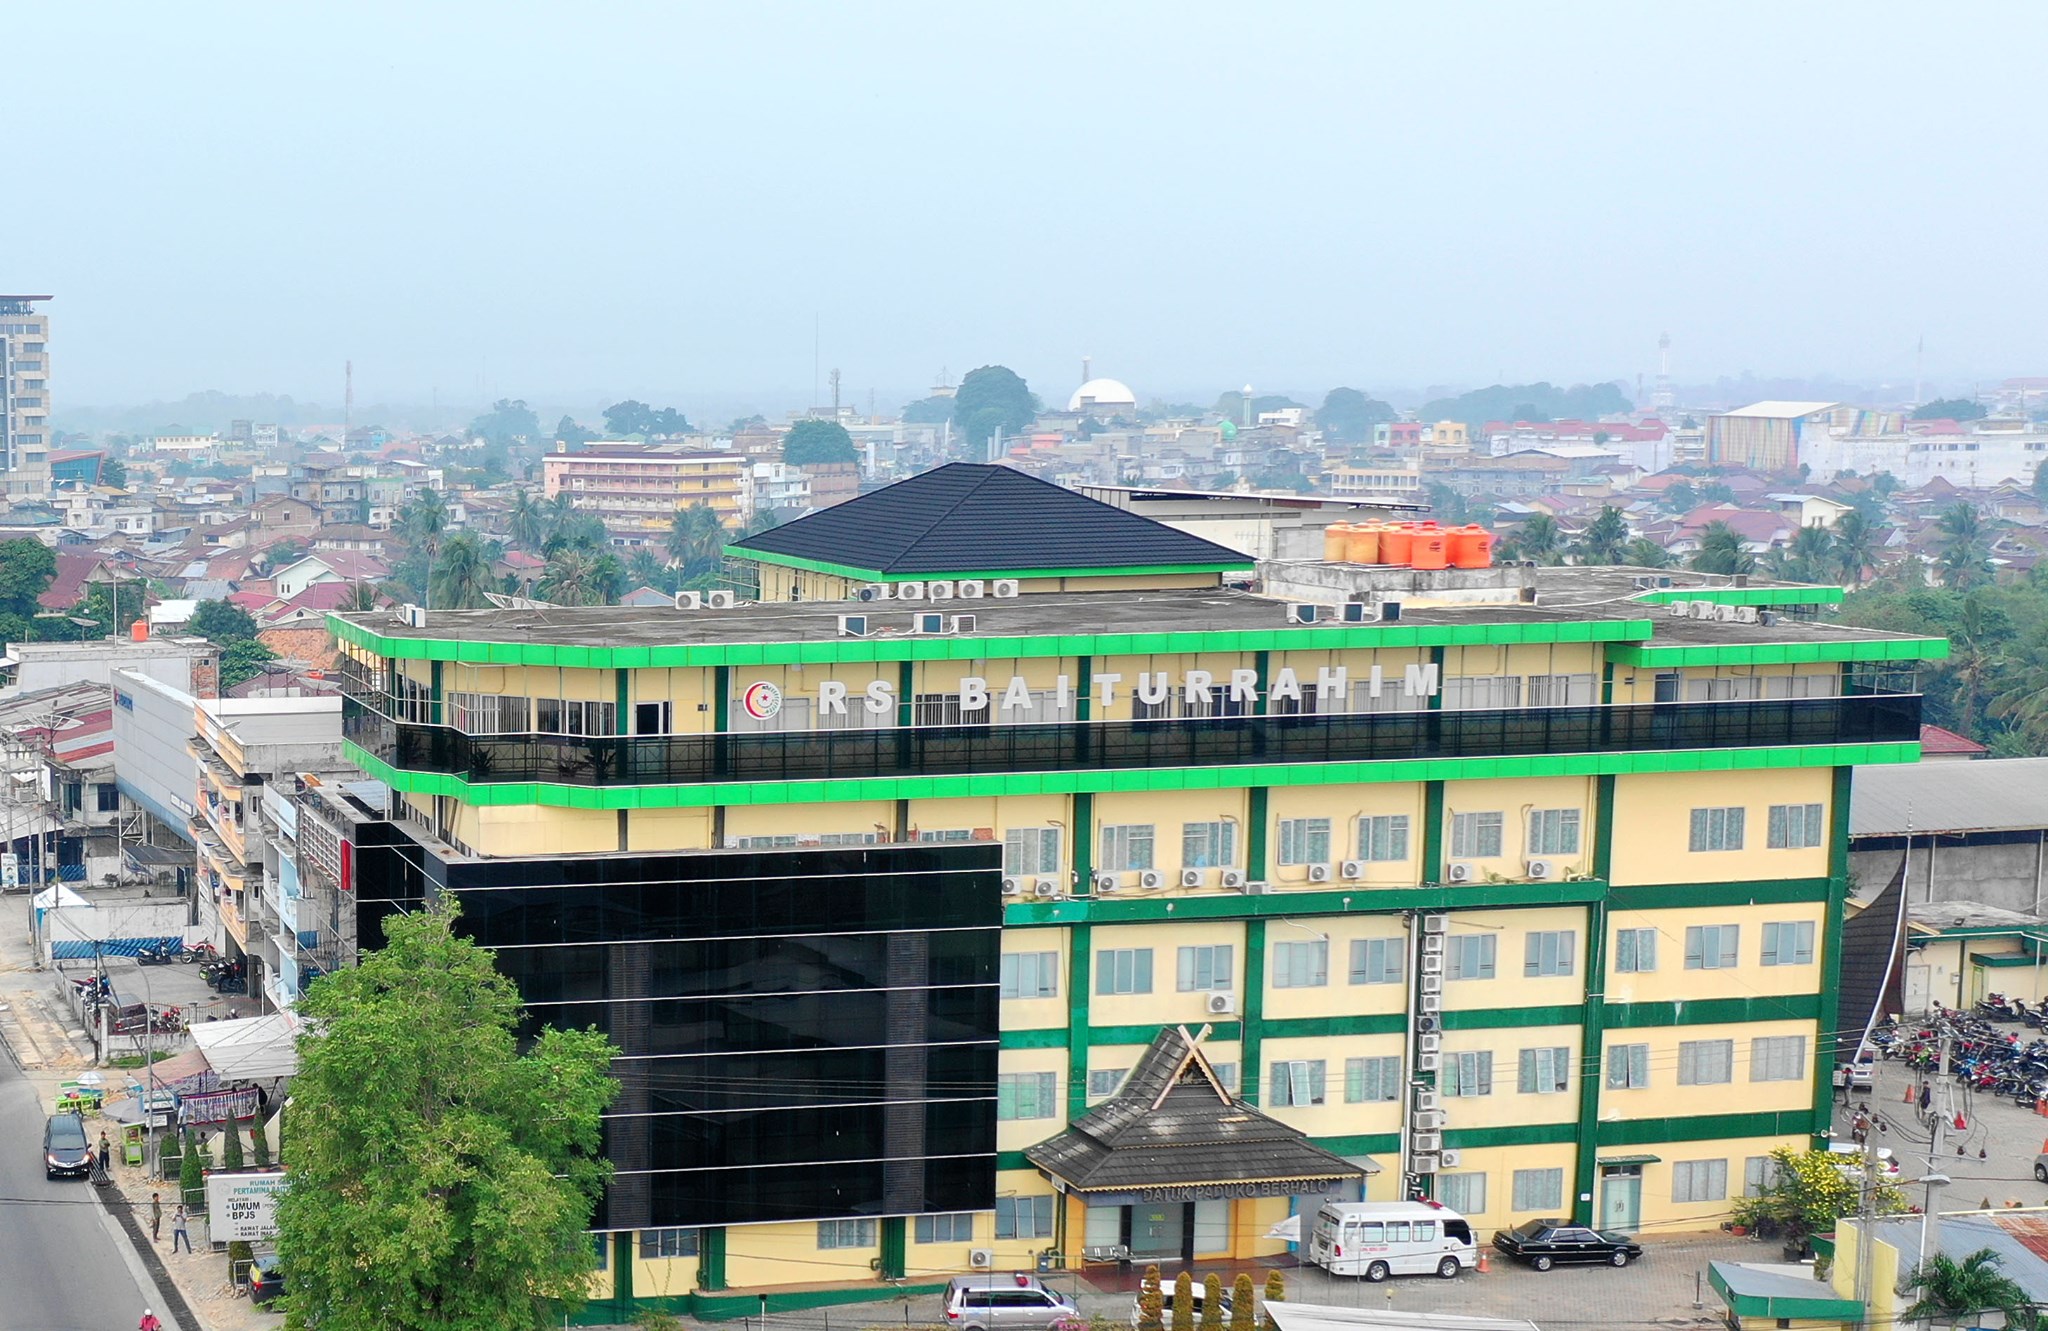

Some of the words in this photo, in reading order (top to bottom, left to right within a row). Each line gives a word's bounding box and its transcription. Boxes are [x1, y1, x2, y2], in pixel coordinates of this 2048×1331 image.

[818, 680, 893, 715] RS
[959, 663, 1439, 711] BAITURRAHIM
[233, 1186, 270, 1195] PERTAMINA
[1143, 1186, 1191, 1202] DATUK
[1196, 1184, 1256, 1199] PADUKO
[1261, 1180, 1329, 1196] BERHALO
[231, 1201, 260, 1211] UMUM
[232, 1211, 256, 1220] BPJS
